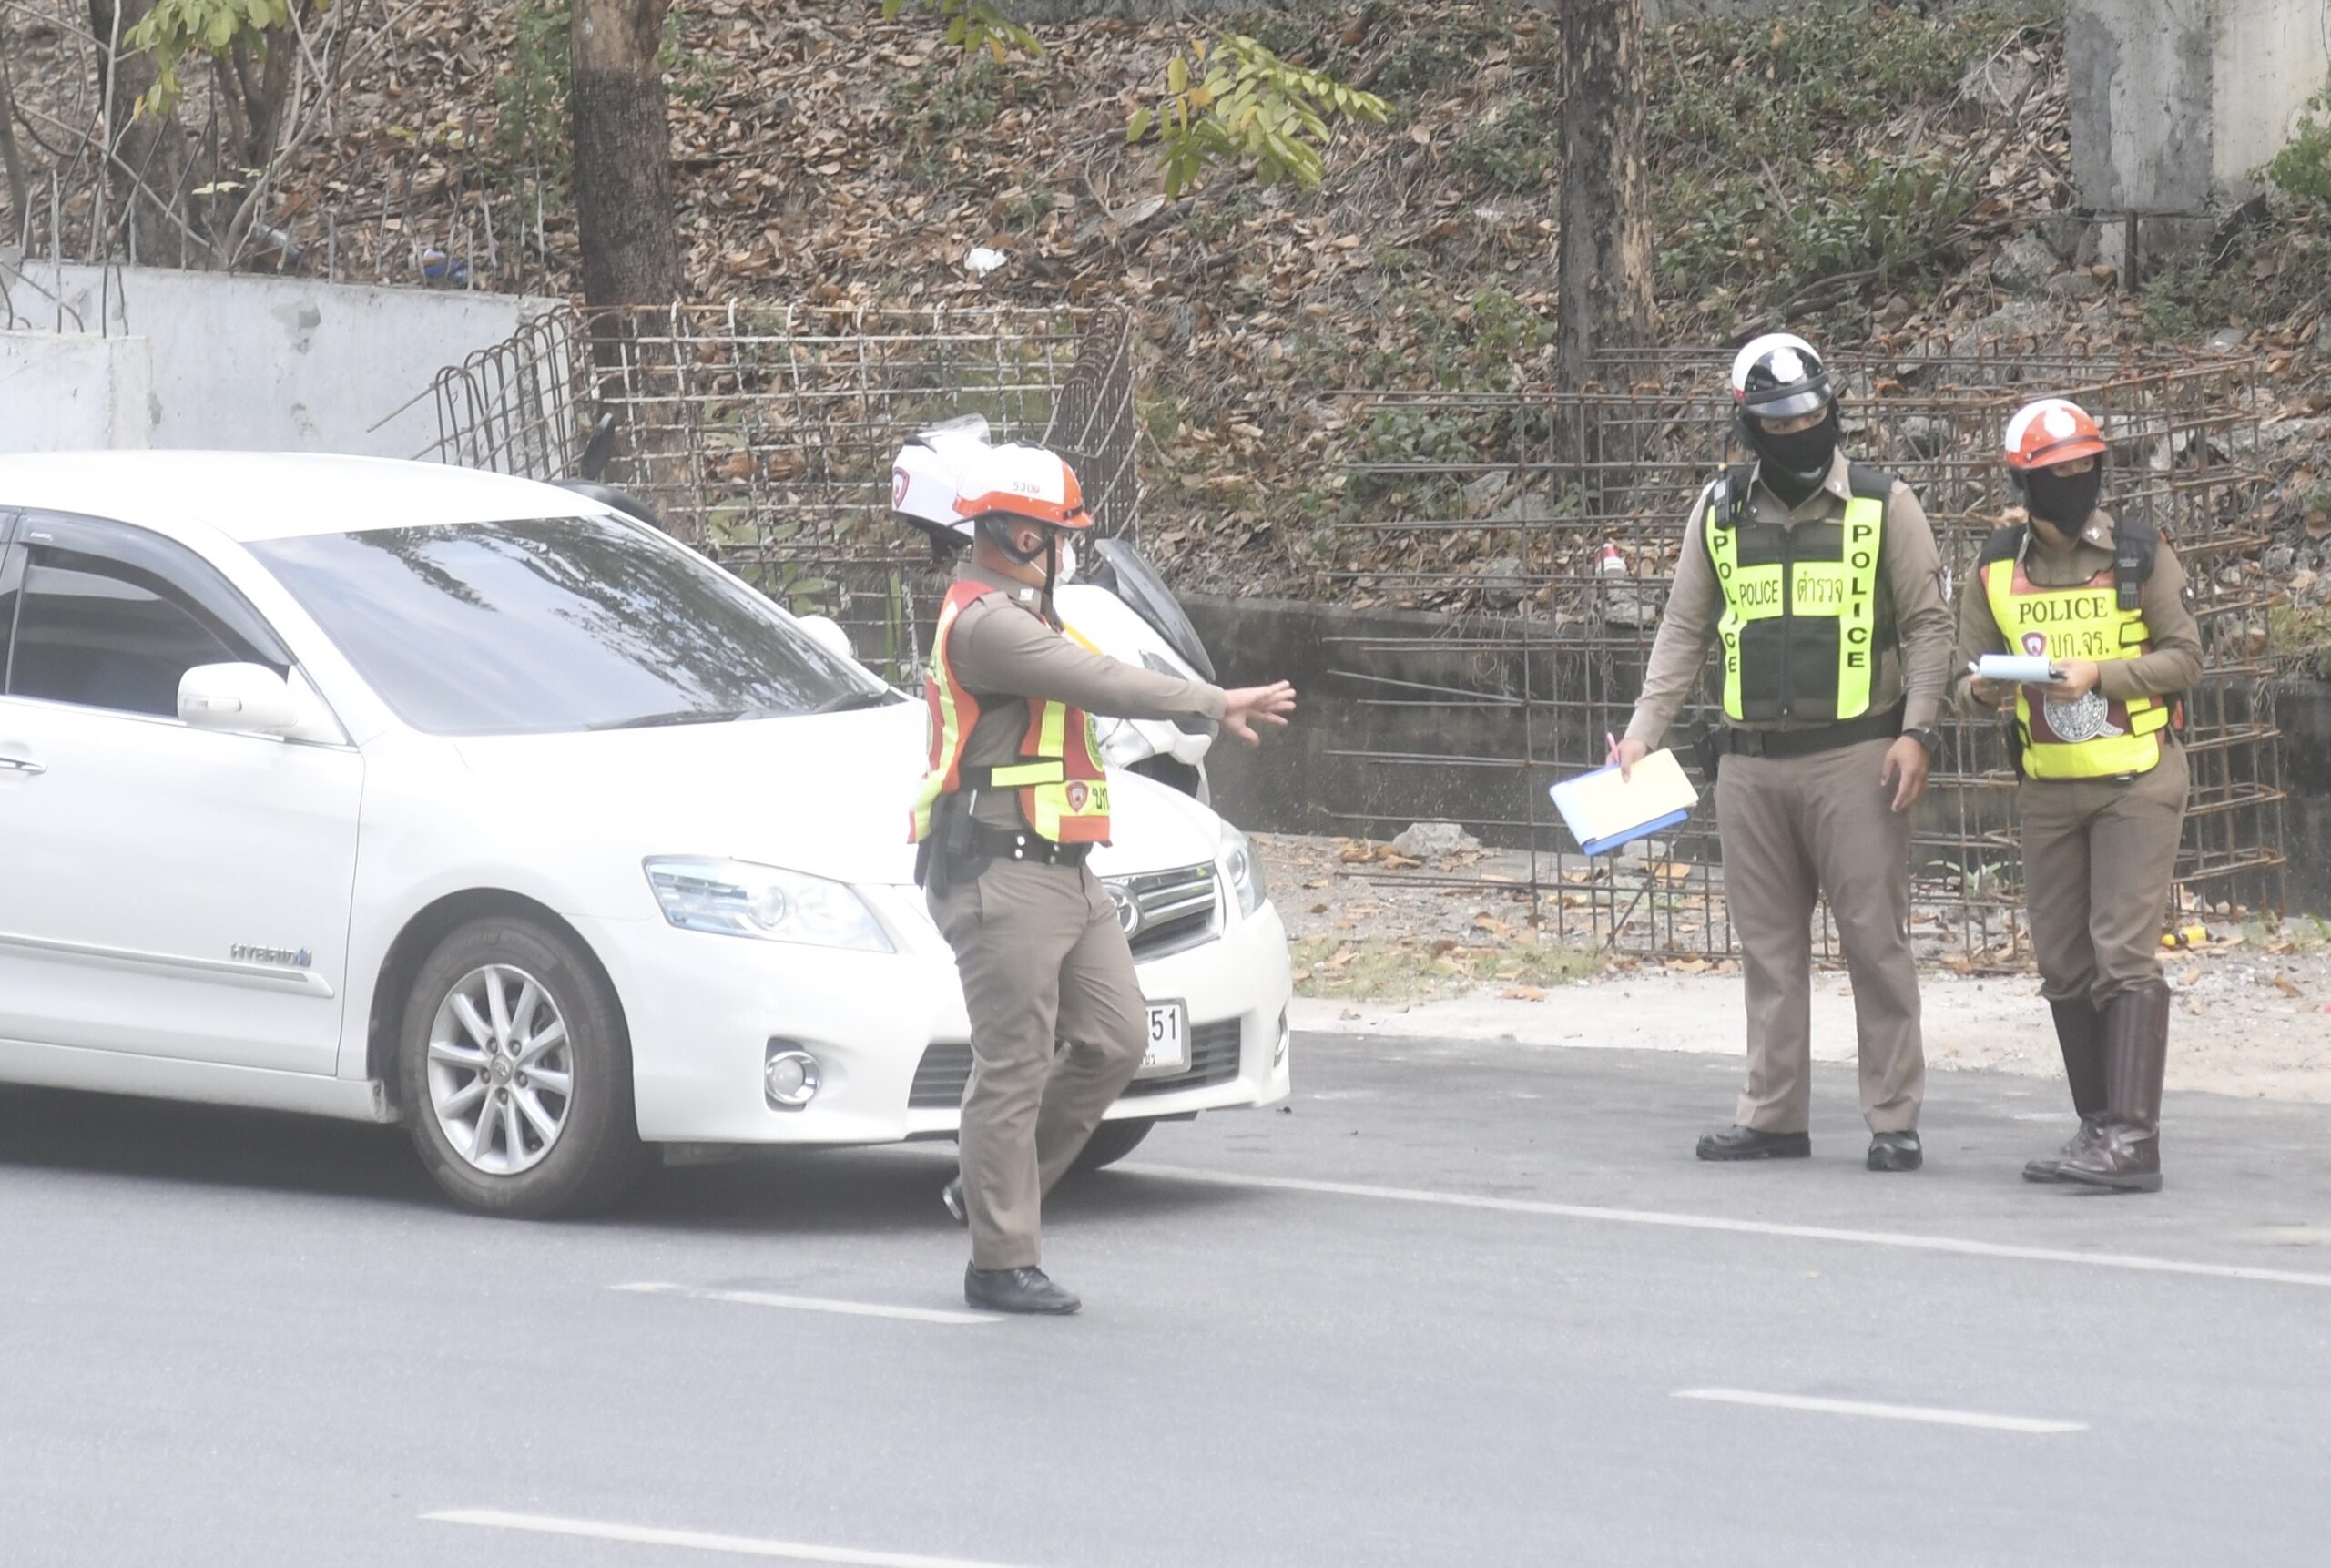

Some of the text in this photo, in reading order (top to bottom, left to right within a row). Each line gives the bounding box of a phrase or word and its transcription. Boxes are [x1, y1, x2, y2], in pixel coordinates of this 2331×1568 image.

[1739, 579, 1779, 608] POLICE
[1797, 570, 1844, 604] ตำรวจ
[1847, 524, 1873, 668] POLICE
[2018, 596, 2108, 625] POLICE
[2050, 630, 2110, 658] บก.จร.
[1145, 1007, 1176, 1042] 51
